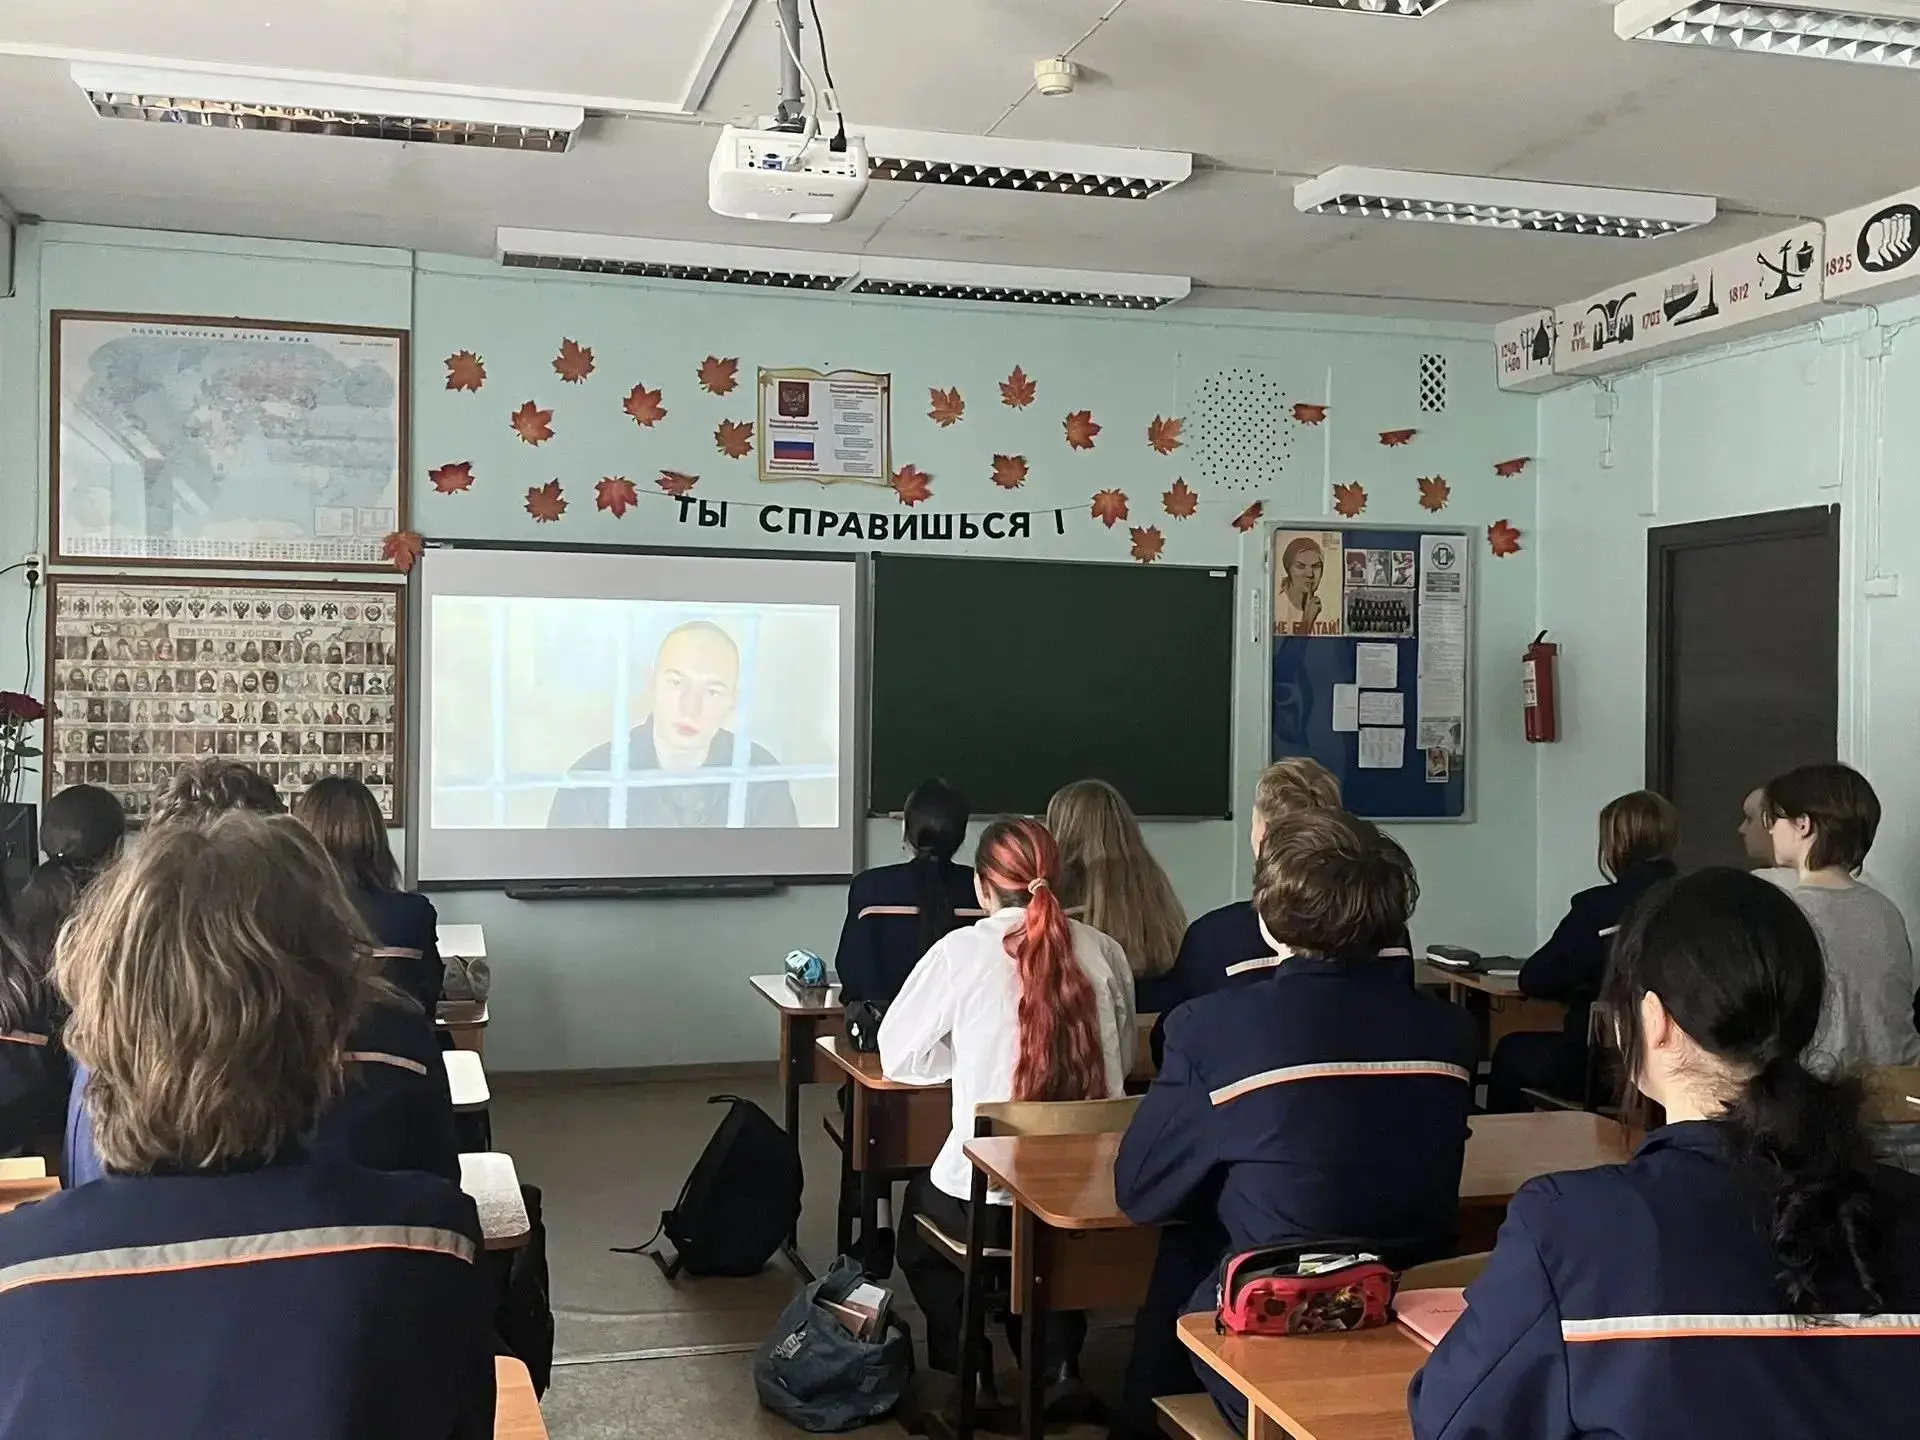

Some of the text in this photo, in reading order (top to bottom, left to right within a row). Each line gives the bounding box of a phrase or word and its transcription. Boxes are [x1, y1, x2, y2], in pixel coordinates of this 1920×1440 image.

[1826, 253, 1852, 277] 1825
[1728, 282, 1749, 304] 1812
[1642, 310, 1660, 330] 1703
[675, 495, 727, 527] ТЫ
[759, 504, 1030, 540] СПРАВИШЬСЯ
[1272, 617, 1341, 635] НЕ БЛТАЙ!
